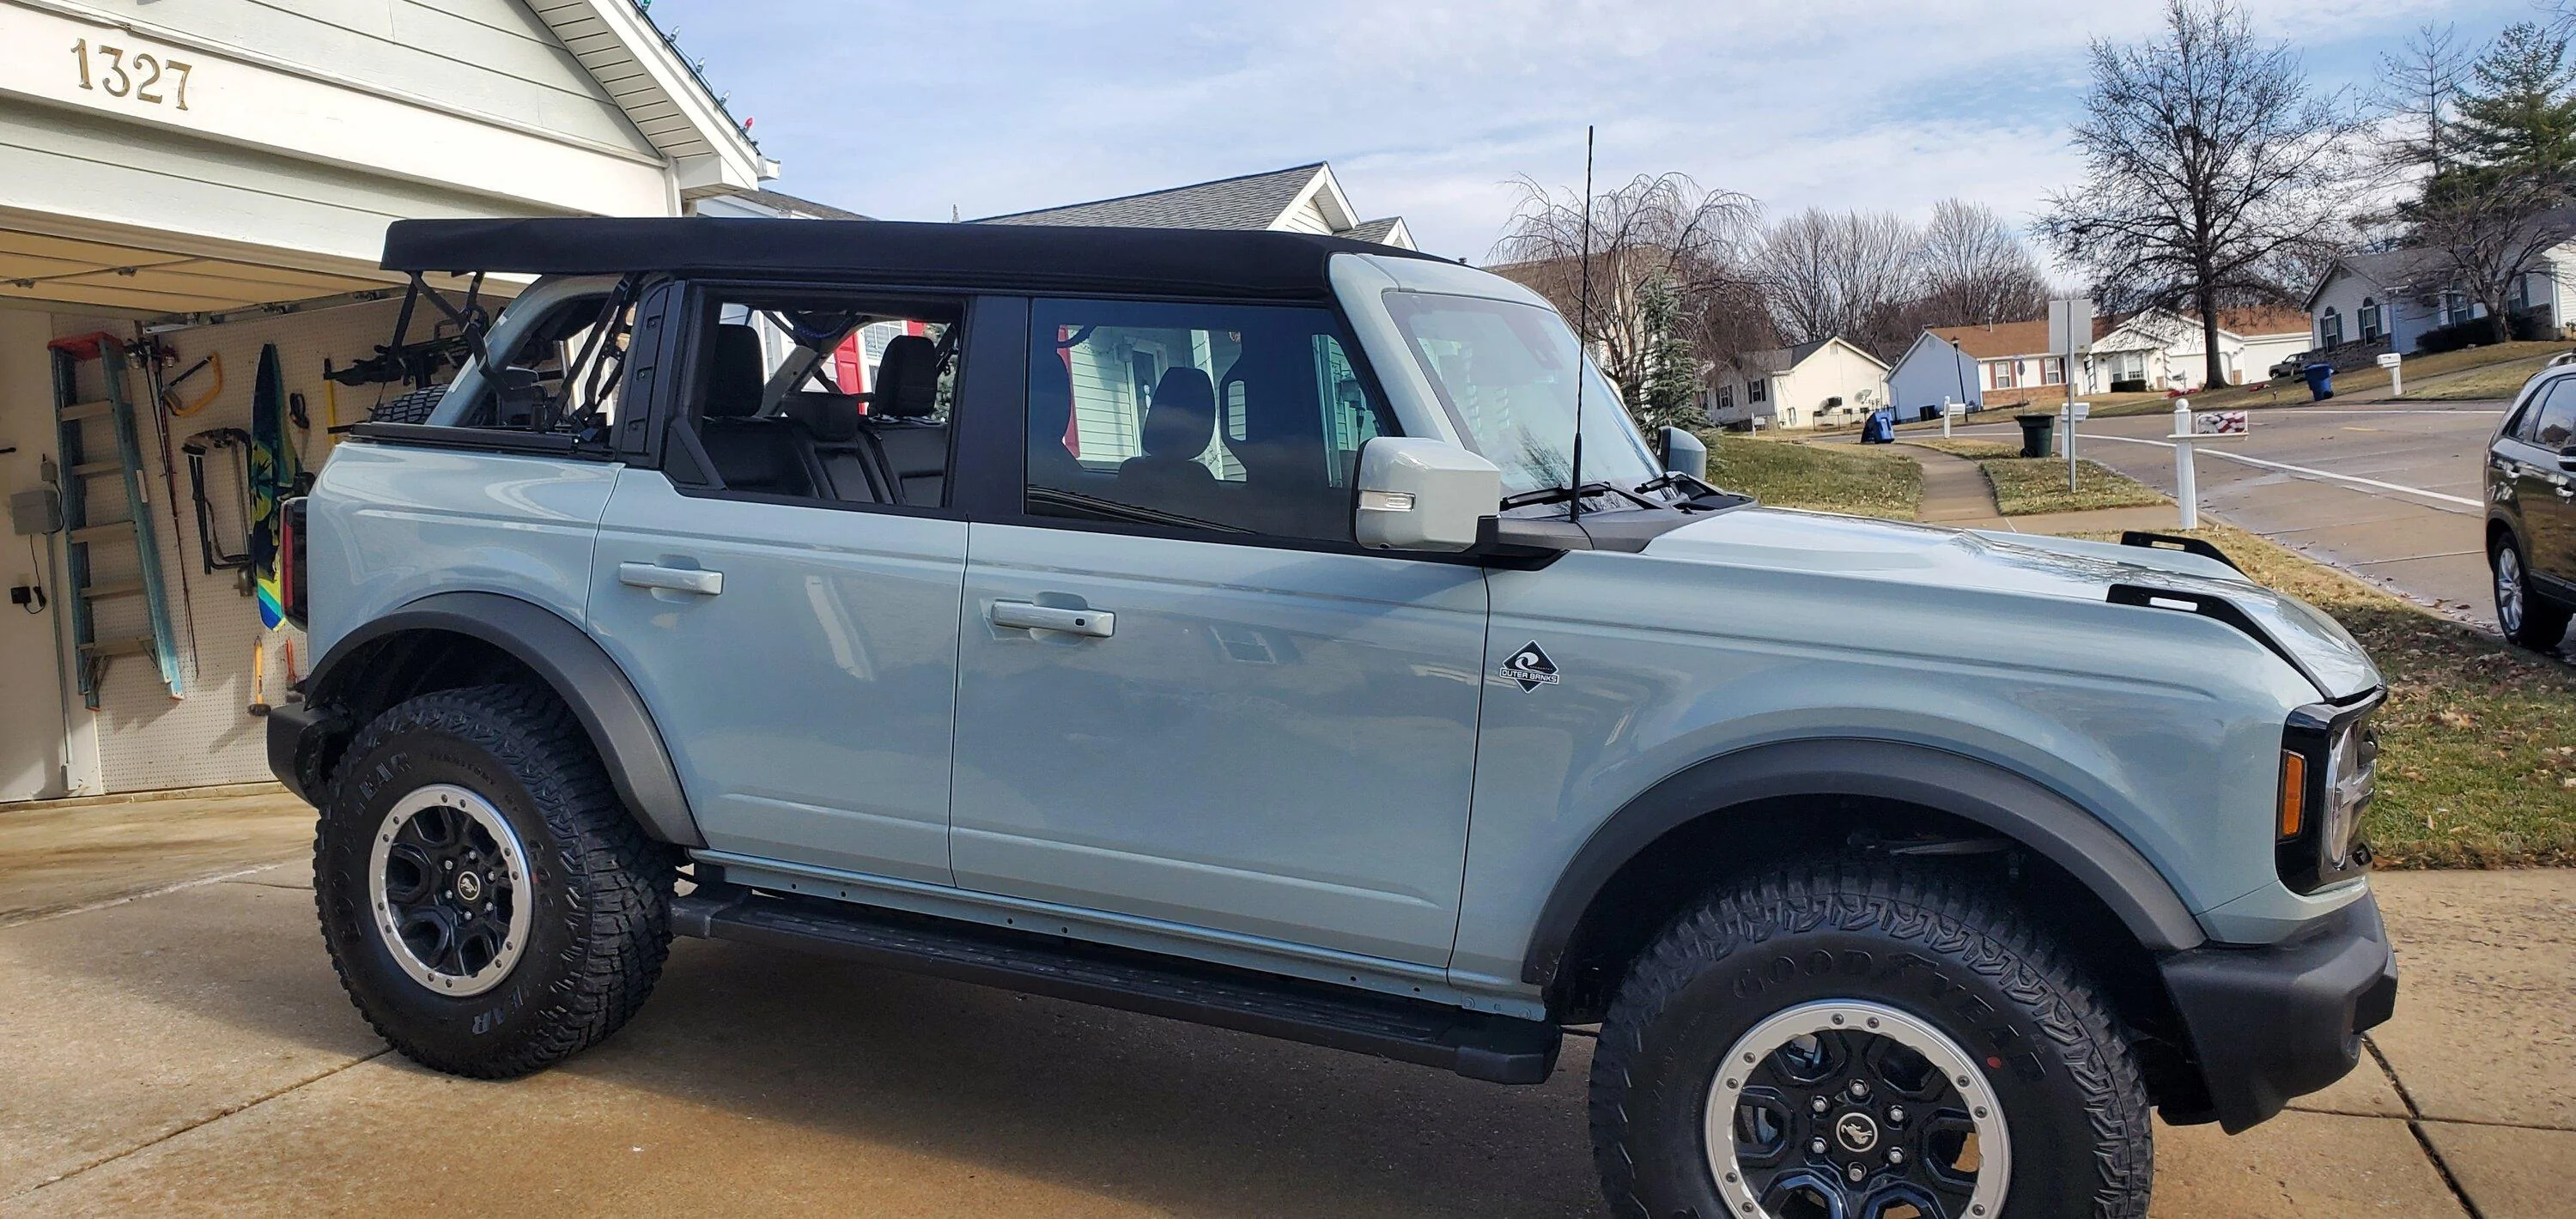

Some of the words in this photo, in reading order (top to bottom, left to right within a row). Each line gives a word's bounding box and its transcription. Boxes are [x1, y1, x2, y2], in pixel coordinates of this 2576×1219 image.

[70, 38, 192, 111] 1327
[1502, 670, 1528, 678] OUTER
[1529, 673, 1557, 682] BANKS
